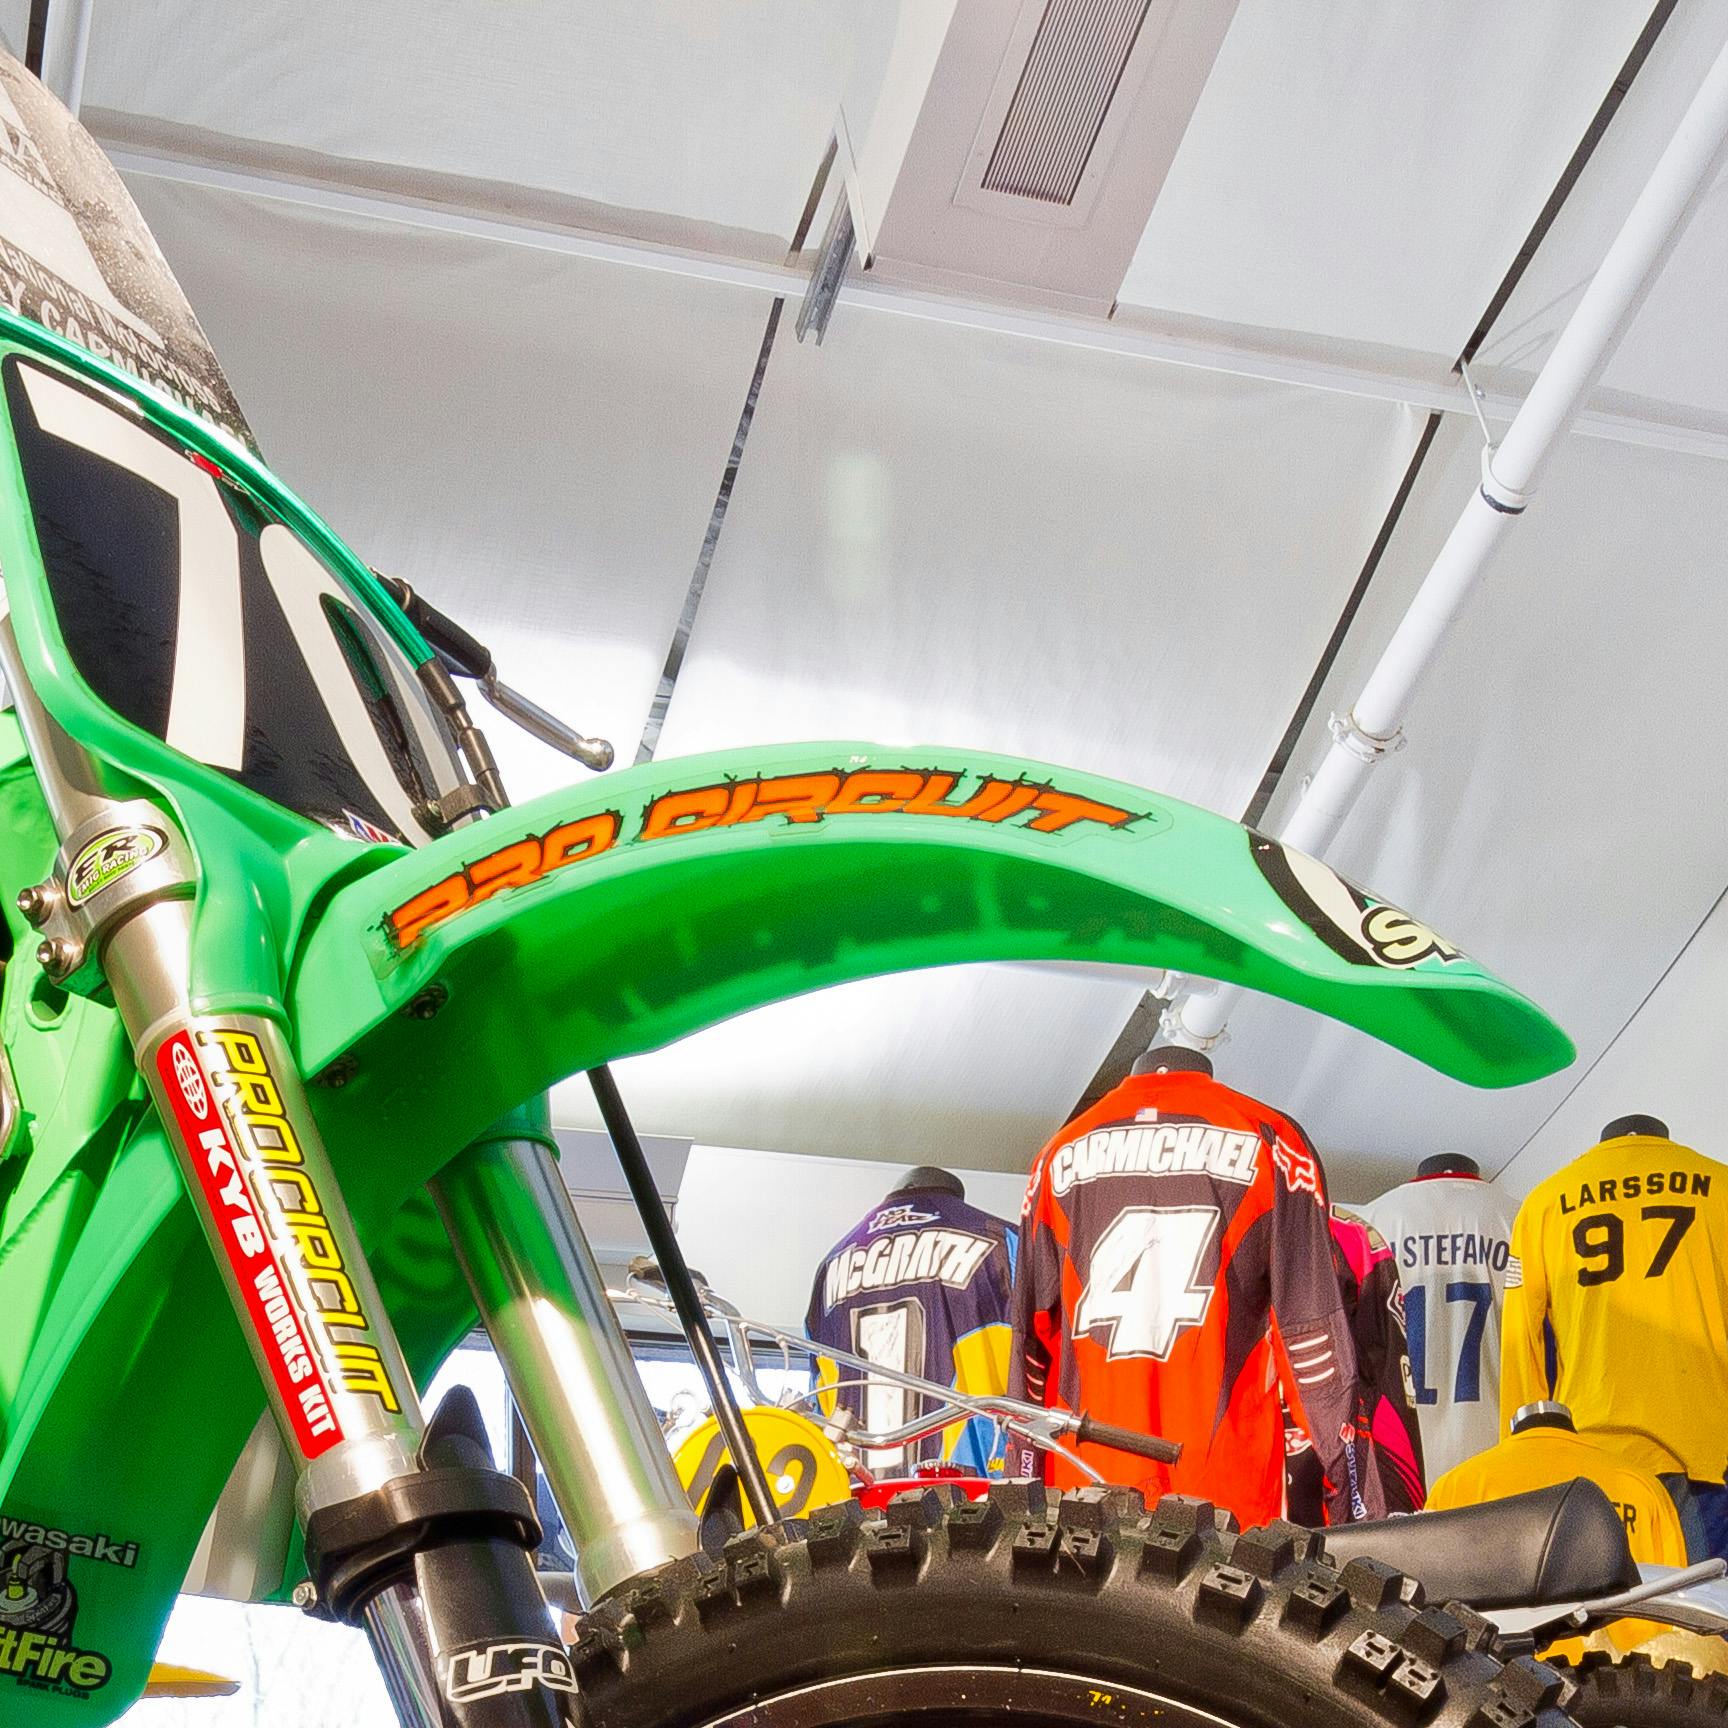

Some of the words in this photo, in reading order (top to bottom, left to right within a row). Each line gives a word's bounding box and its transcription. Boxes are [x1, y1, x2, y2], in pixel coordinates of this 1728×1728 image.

[16, 360, 466, 848] 70
[391, 809, 622, 952] PRO
[643, 768, 1134, 838] CIRCUIT
[196, 1028, 304, 1167] PRO
[1051, 1124, 1260, 1197] CARMICHAEL
[1403, 1233, 1509, 1273] STEFANO
[1560, 1171, 1711, 1215] LARSSON
[1572, 1205, 1696, 1287] 97
[198, 1127, 265, 1259] KYB
[253, 1264, 313, 1384] WORKS
[298, 1382, 336, 1439] KIT
[248, 1165, 402, 1414] CIRCUIT
[1072, 1206, 1220, 1362] 4
[1404, 1282, 1492, 1405] 17
[445, 1642, 578, 1703] UFO
